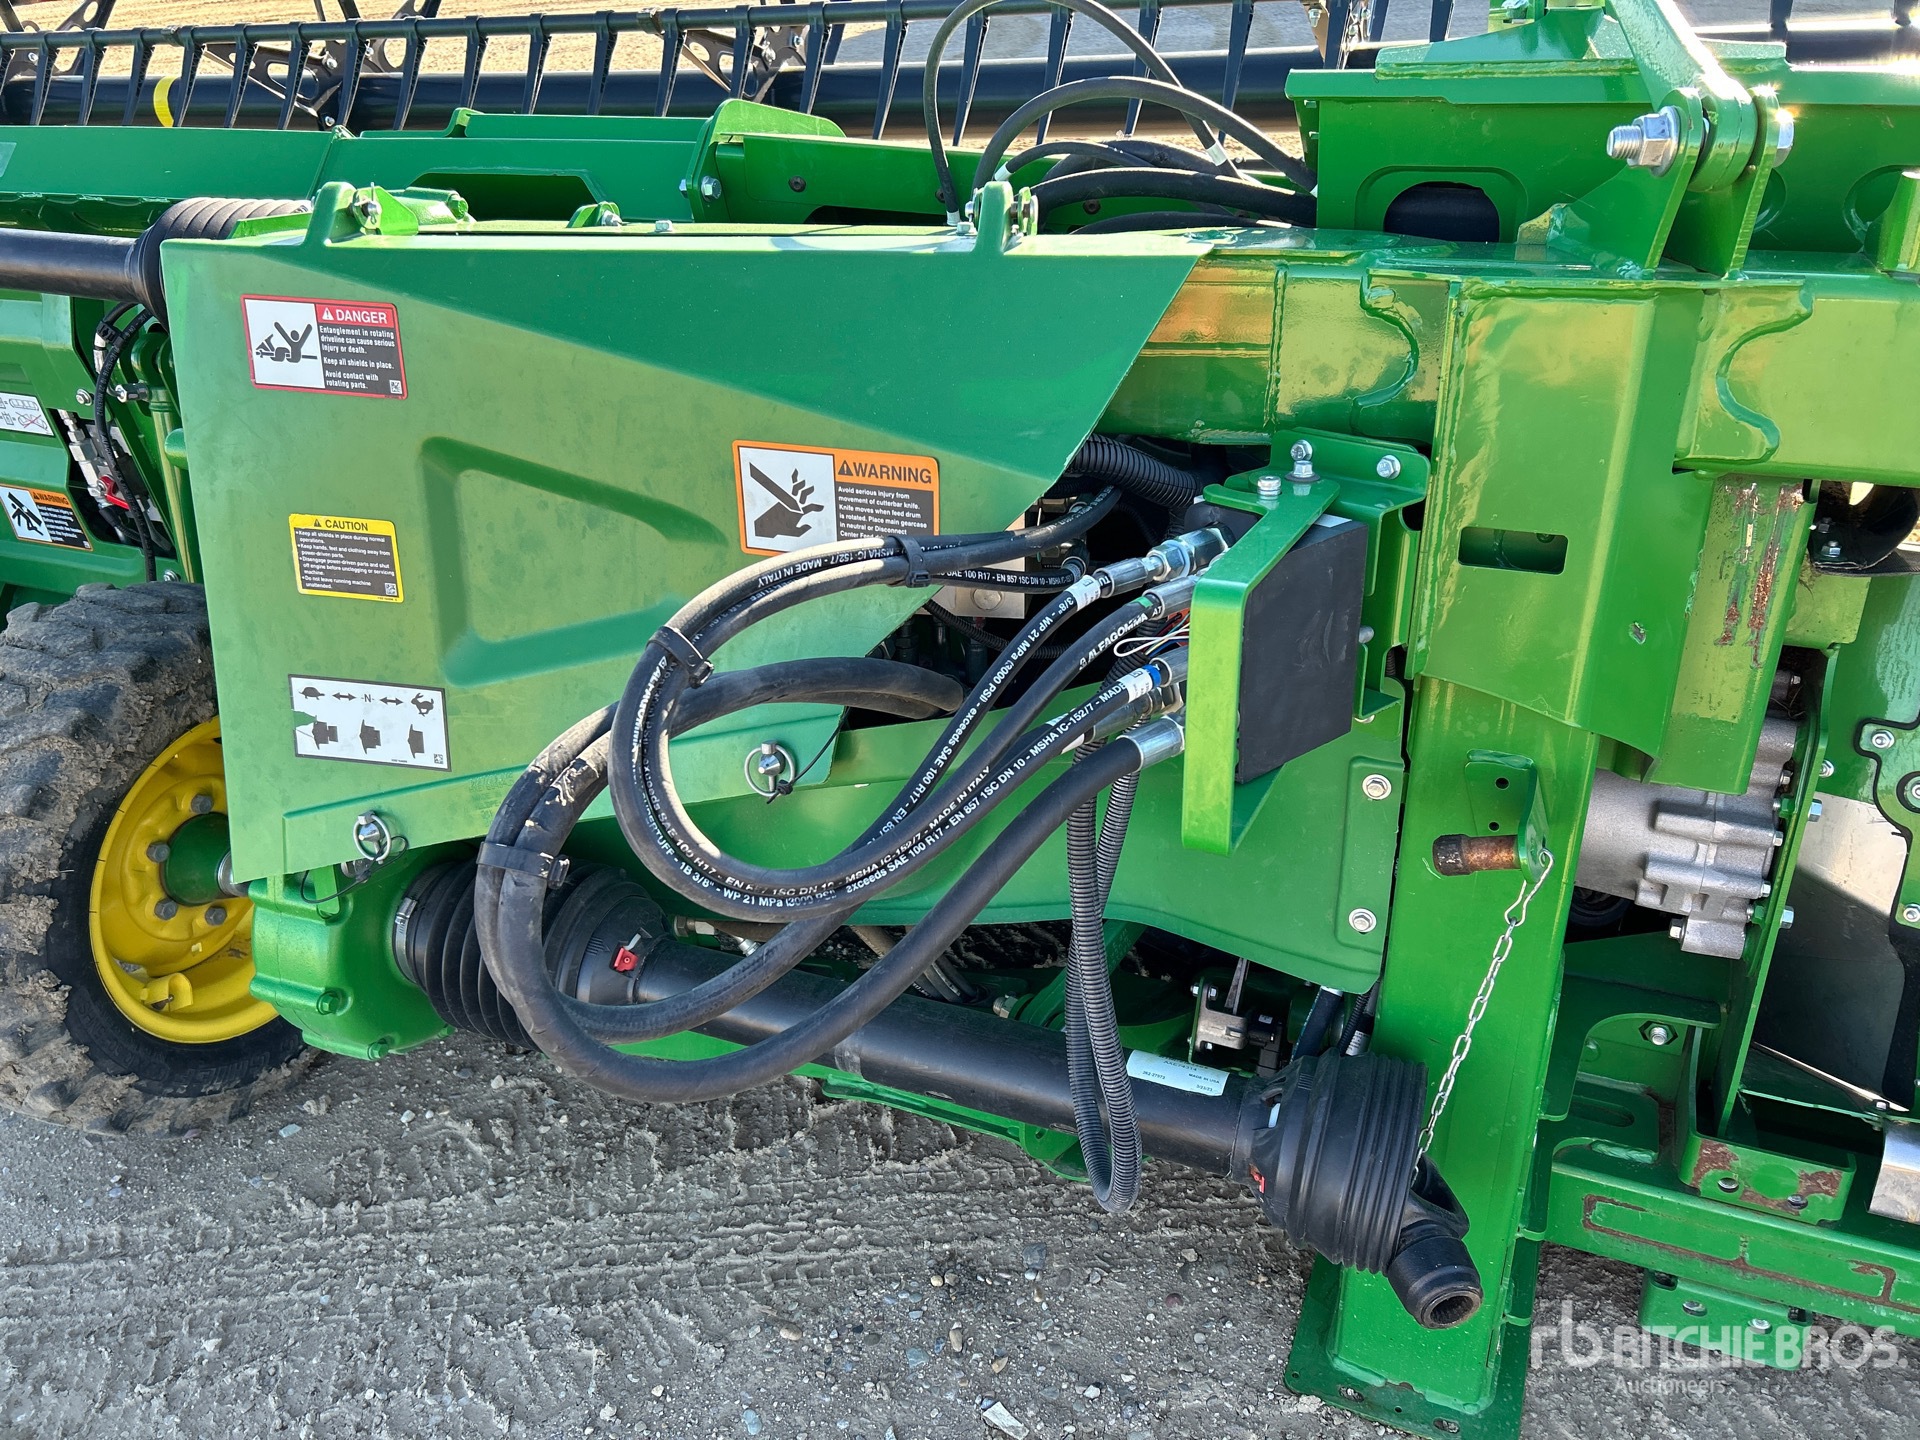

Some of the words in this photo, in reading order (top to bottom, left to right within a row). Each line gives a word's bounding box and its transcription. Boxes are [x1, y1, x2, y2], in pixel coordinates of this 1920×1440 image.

[336, 309, 387, 324] DANGER
[320, 326, 361, 335] Entanglement
[370, 330, 394, 339] rotating
[348, 346, 367, 354] death.
[374, 339, 395, 347] serious
[324, 357, 337, 366] Keep
[348, 359, 368, 367] shields
[376, 361, 394, 369] place.
[326, 370, 341, 378] Avoid
[327, 380, 349, 388] rotating
[853, 462, 931, 484] WARNING
[878, 491, 895, 499] injury
[325, 520, 368, 531] CAUTION
[875, 526, 907, 534] Disconnect
[784, 566, 794, 577] IN
[796, 558, 821, 574] MADE
[758, 571, 782, 588] ITALY
[965, 570, 977, 579] 100
[978, 571, 991, 581] R17
[996, 574, 1006, 583] EN
[1007, 575, 1018, 584] 857
[1019, 576, 1030, 585] 1SC
[1058, 596, 1074, 614] 3/8"
[1039, 615, 1054, 633] WP
[1027, 629, 1040, 643] 21
[1011, 640, 1031, 661] MPa
[993, 659, 1015, 685] (3000
[979, 683, 996, 703] PSI)
[948, 707, 978, 746] exceeds
[934, 745, 953, 768] SAE
[922, 767, 938, 785] 100
[680, 861, 693, 876] 1B
[692, 871, 715, 888] 3/8"
[723, 887, 742, 900] WP
[742, 894, 755, 906] 21
[758, 897, 783, 908] MPa
[887, 853, 909, 873] SAE
[908, 841, 926, 858] 100
[925, 827, 944, 846] R17
[949, 811, 965, 827] EN
[963, 797, 982, 815] 857
[980, 781, 1000, 799] 1SC
[997, 768, 1015, 784] DN
[1013, 758, 1026, 770] 10
[1029, 732, 1059, 758] MSHA
[1058, 702, 1095, 735] IC-152/7
[1099, 682, 1128, 703] MADE
[909, 785, 927, 804] R17
[892, 806, 908, 824] EN
[725, 875, 745, 889] EN
[799, 885, 817, 896] DN
[846, 865, 878, 884] MSHA
[929, 802, 957, 829] MADE
[957, 791, 968, 804] IN
[967, 765, 990, 792] ITALY
